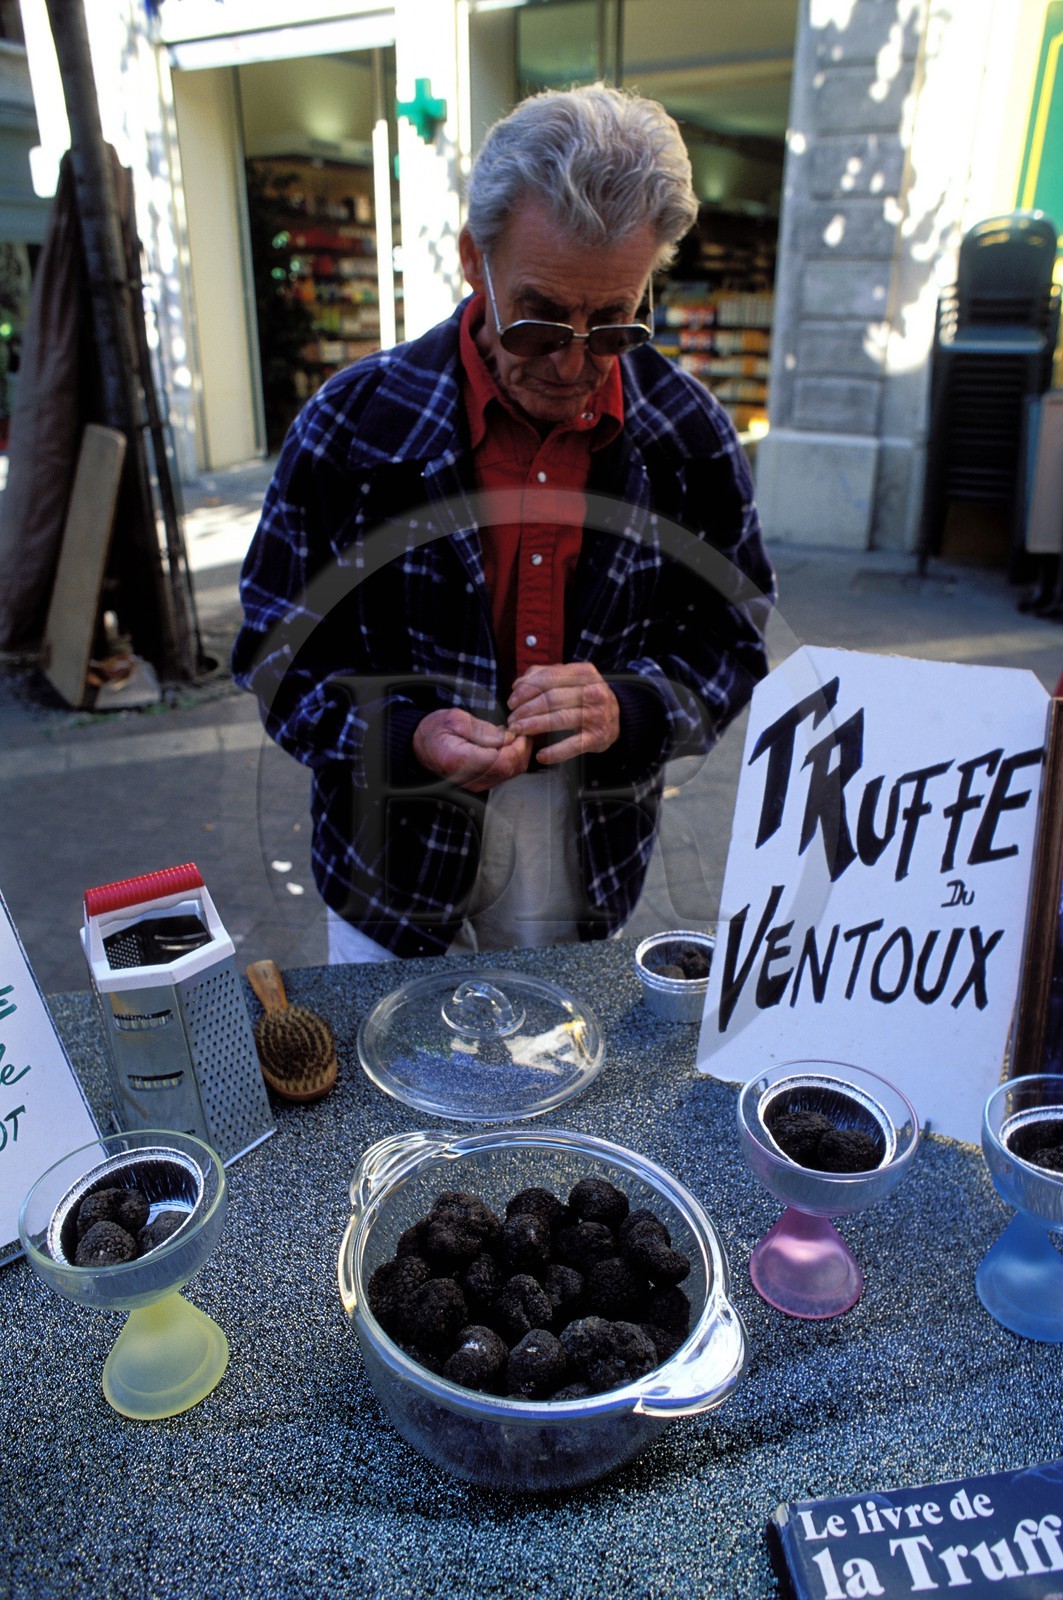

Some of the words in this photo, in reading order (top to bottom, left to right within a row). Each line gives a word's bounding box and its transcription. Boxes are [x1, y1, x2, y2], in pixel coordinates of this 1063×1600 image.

[748, 675, 1045, 882] TRUFFE
[718, 885, 1005, 1033] VENTOUX
[797, 1508, 848, 1541] Le
[851, 1500, 943, 1534] livre
[949, 1488, 994, 1521] de
[812, 1546, 886, 1600] la
